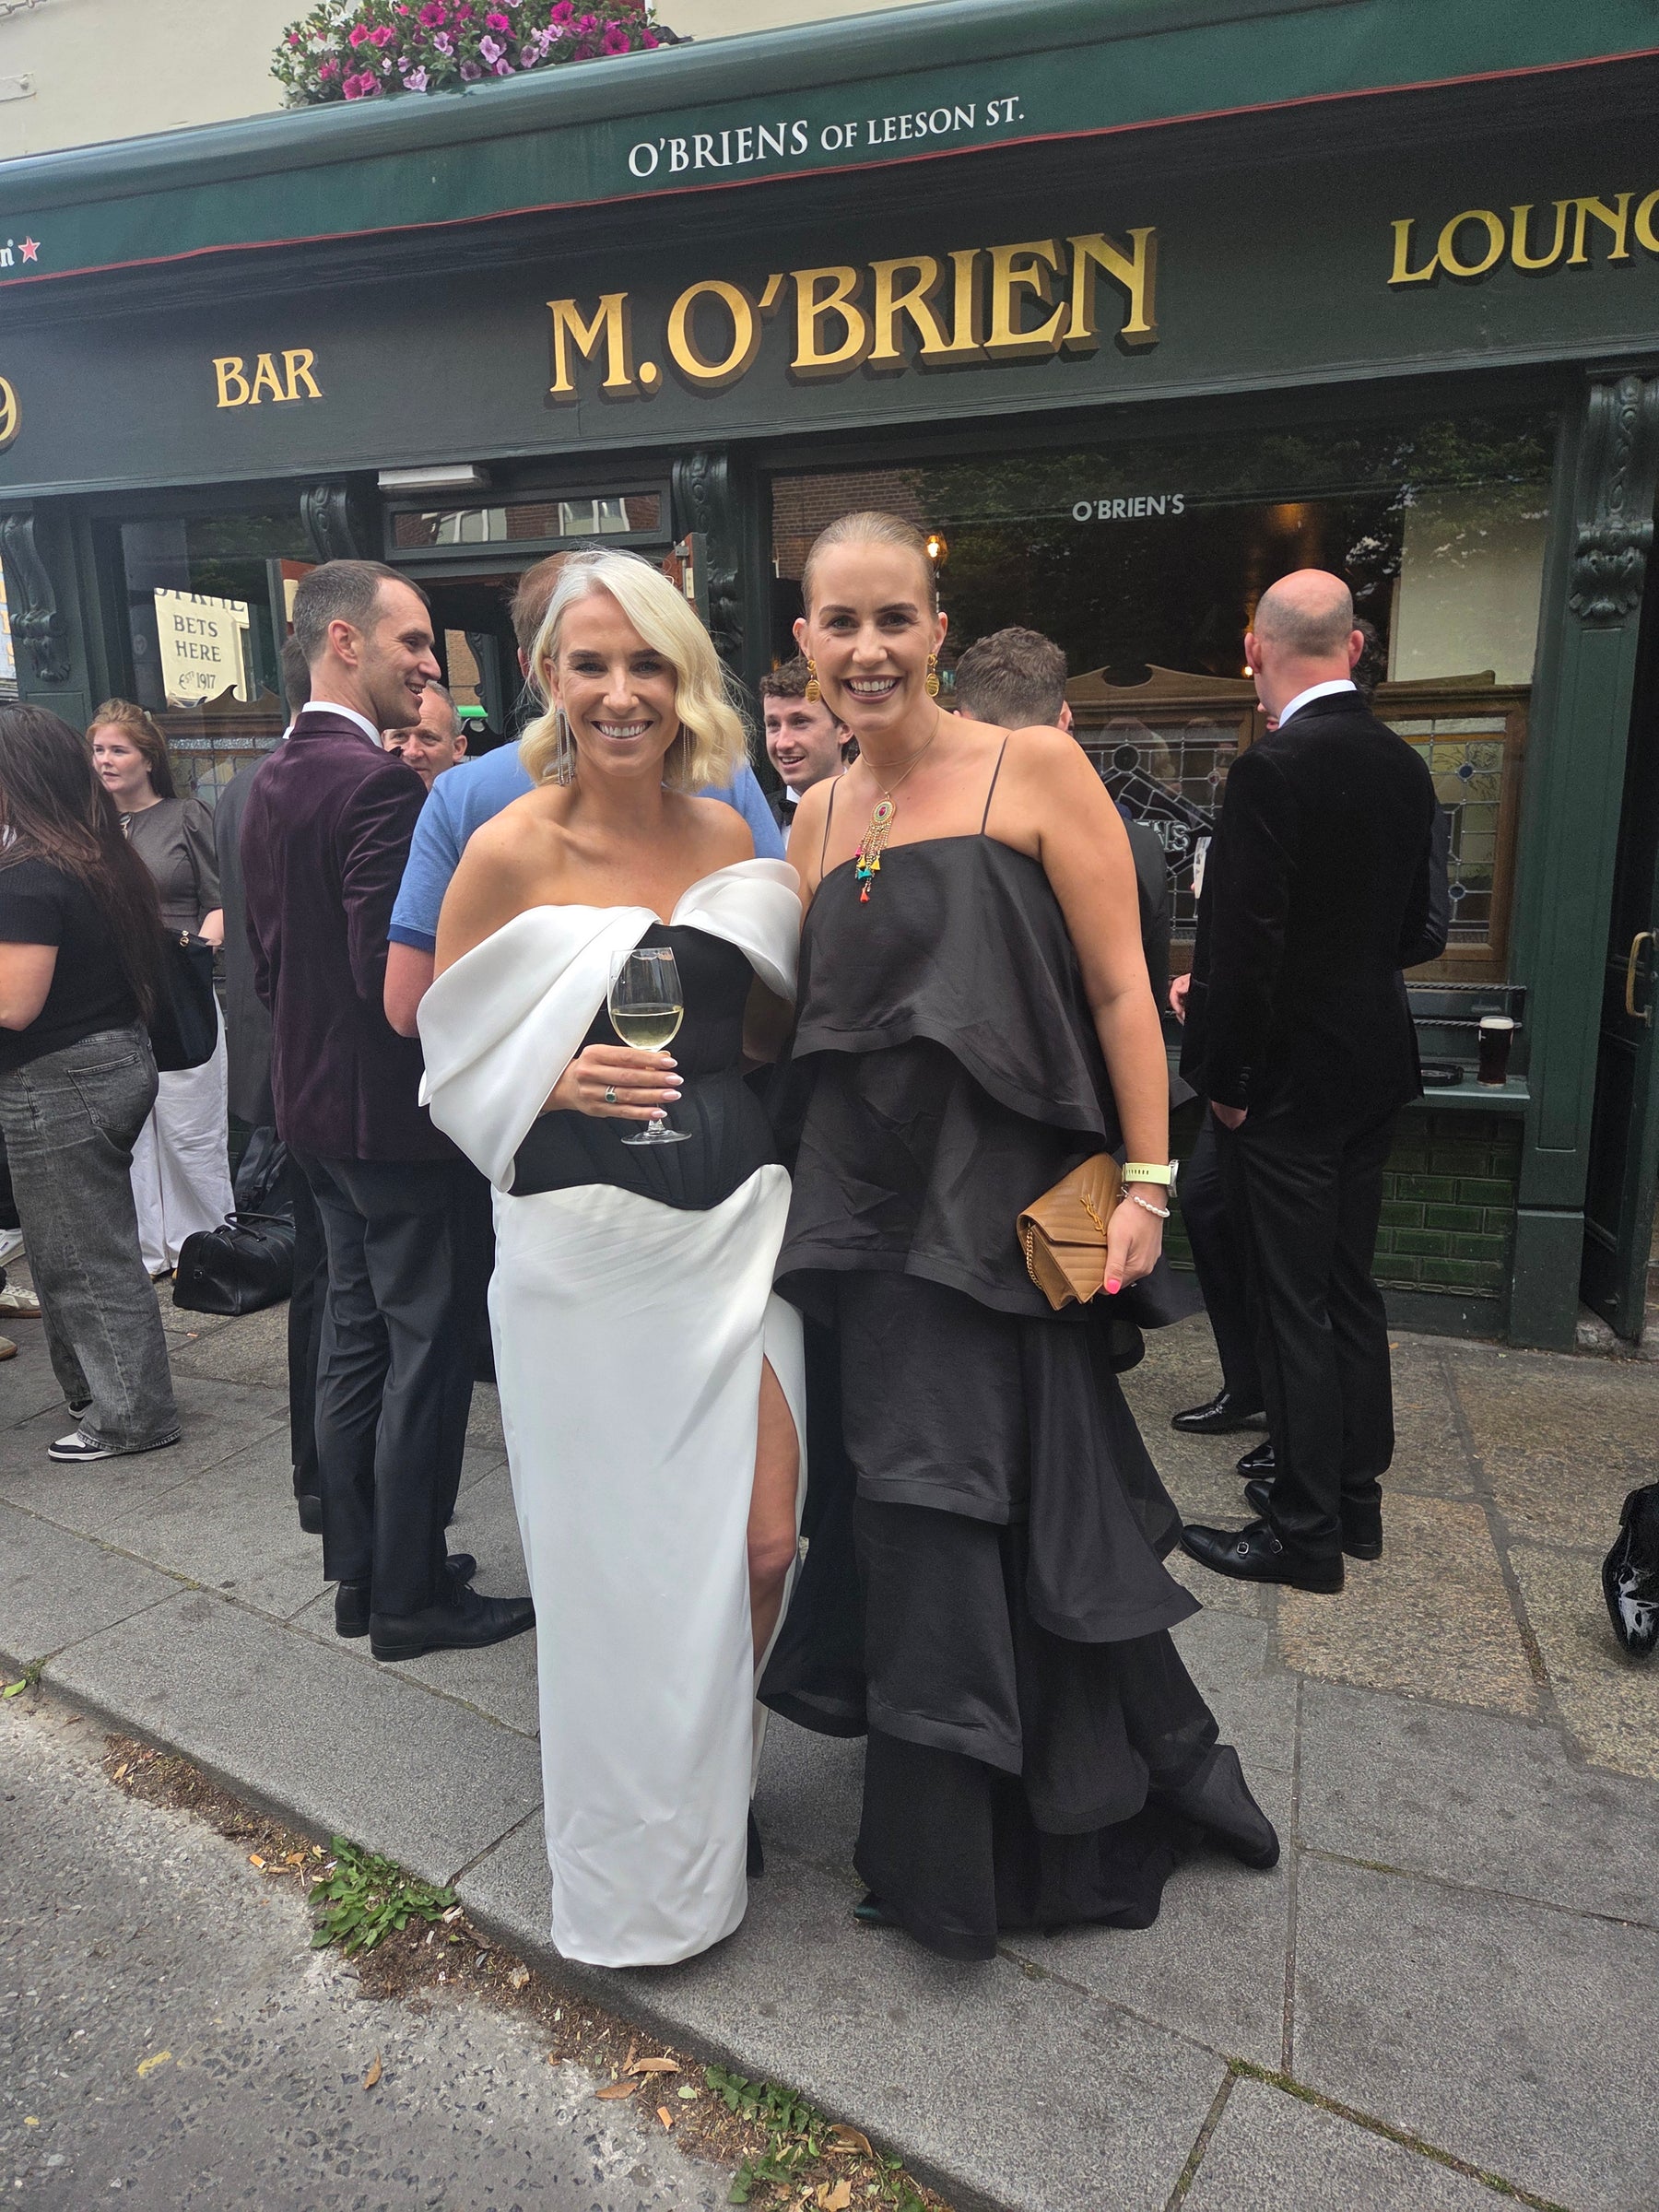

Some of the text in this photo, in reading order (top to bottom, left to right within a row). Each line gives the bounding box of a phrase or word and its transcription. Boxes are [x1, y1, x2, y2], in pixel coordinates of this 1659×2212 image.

[629, 96, 1025, 177] O'BRIENS OF LEESON ST.
[212, 348, 322, 407] BAR
[1072, 493, 1184, 522] O'BRIEN'S
[173, 614, 218, 638] BETS
[175, 640, 221, 663] HERE
[196, 672, 216, 689] 1917
